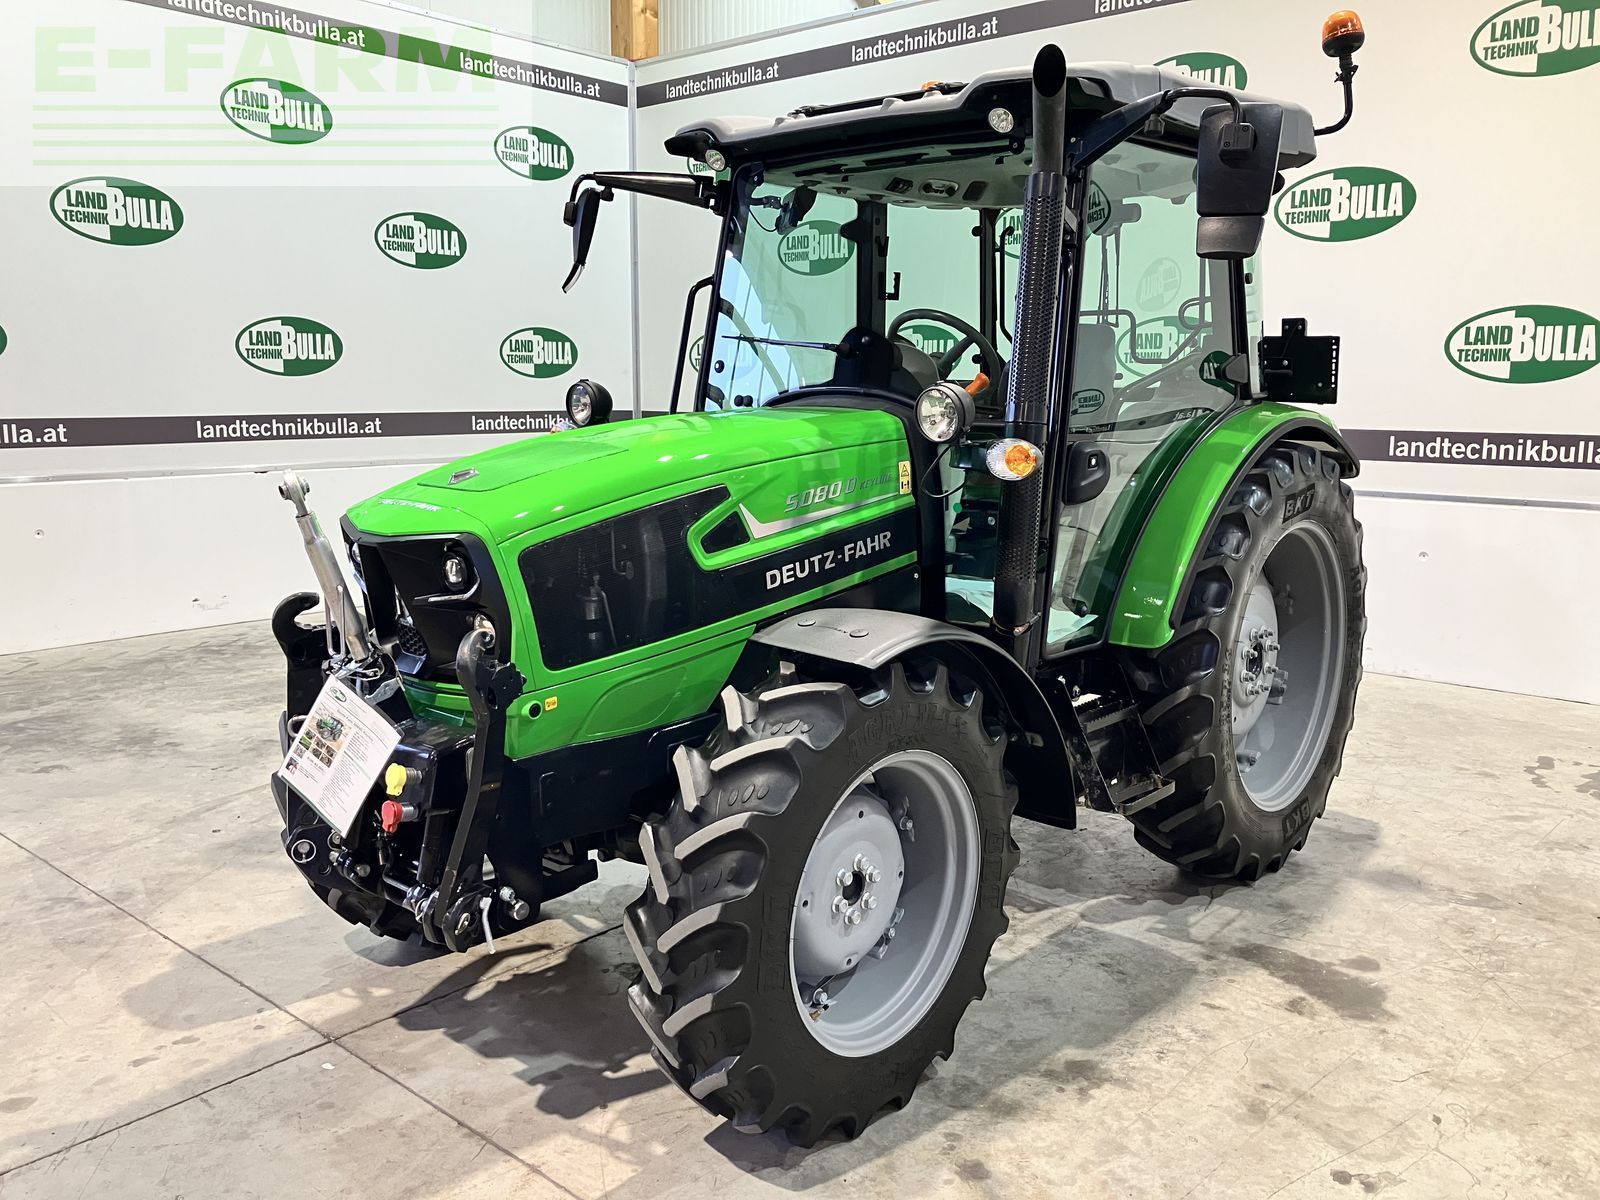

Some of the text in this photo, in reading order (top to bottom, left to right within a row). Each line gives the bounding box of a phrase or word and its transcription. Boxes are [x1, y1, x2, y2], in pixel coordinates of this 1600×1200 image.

[167, 0, 365, 48] andtechnikbulla.at
[1490, 16, 1540, 42] LAND
[1540, 5, 1600, 53] BULL
[851, 17, 998, 62] landtechnikbulla.at
[1483, 40, 1538, 61] TECHNIK
[459, 32, 600, 97] landtechnikbulla.at
[666, 62, 779, 99] landtechnikbulla.at
[234, 88, 269, 110] LAND
[268, 87, 324, 132] BULLA
[230, 106, 270, 124] TECHNIK
[504, 135, 528, 151] LAND
[528, 133, 568, 170] BULLA
[501, 150, 529, 164] TECHNIK
[692, 163, 710, 173] TECH
[66, 189, 107, 210] LAND
[108, 186, 174, 231] BULLA
[1290, 188, 1331, 209] LAND
[1330, 179, 1402, 221] BULLA
[62, 209, 109, 225] TECHNIK
[1285, 209, 1331, 224] TECHNIK
[386, 223, 414, 240] LAND
[414, 220, 460, 256] BULLA
[383, 240, 415, 253] TECHNIK
[786, 235, 809, 250] LAND
[809, 228, 848, 260] BULLA
[783, 250, 809, 263] TECHNIK
[249, 330, 282, 346] LAND
[282, 325, 335, 360] BULLA
[509, 339, 534, 353] LAND
[1130, 333, 1163, 349] AND
[1464, 326, 1513, 346] LAND
[1511, 316, 1596, 362] BULLA
[245, 348, 283, 360] TECHNIK
[507, 354, 534, 364] TECHNIK
[533, 334, 572, 365] BULLA
[1457, 348, 1511, 363] TECHNIK
[197, 417, 381, 439] landtechnikbulla.at
[472, 414, 563, 431] landtechnikb
[0, 423, 67, 444] lla.at
[1286, 488, 1315, 517] BKT
[766, 531, 892, 590] DEUTZ-FAHR
